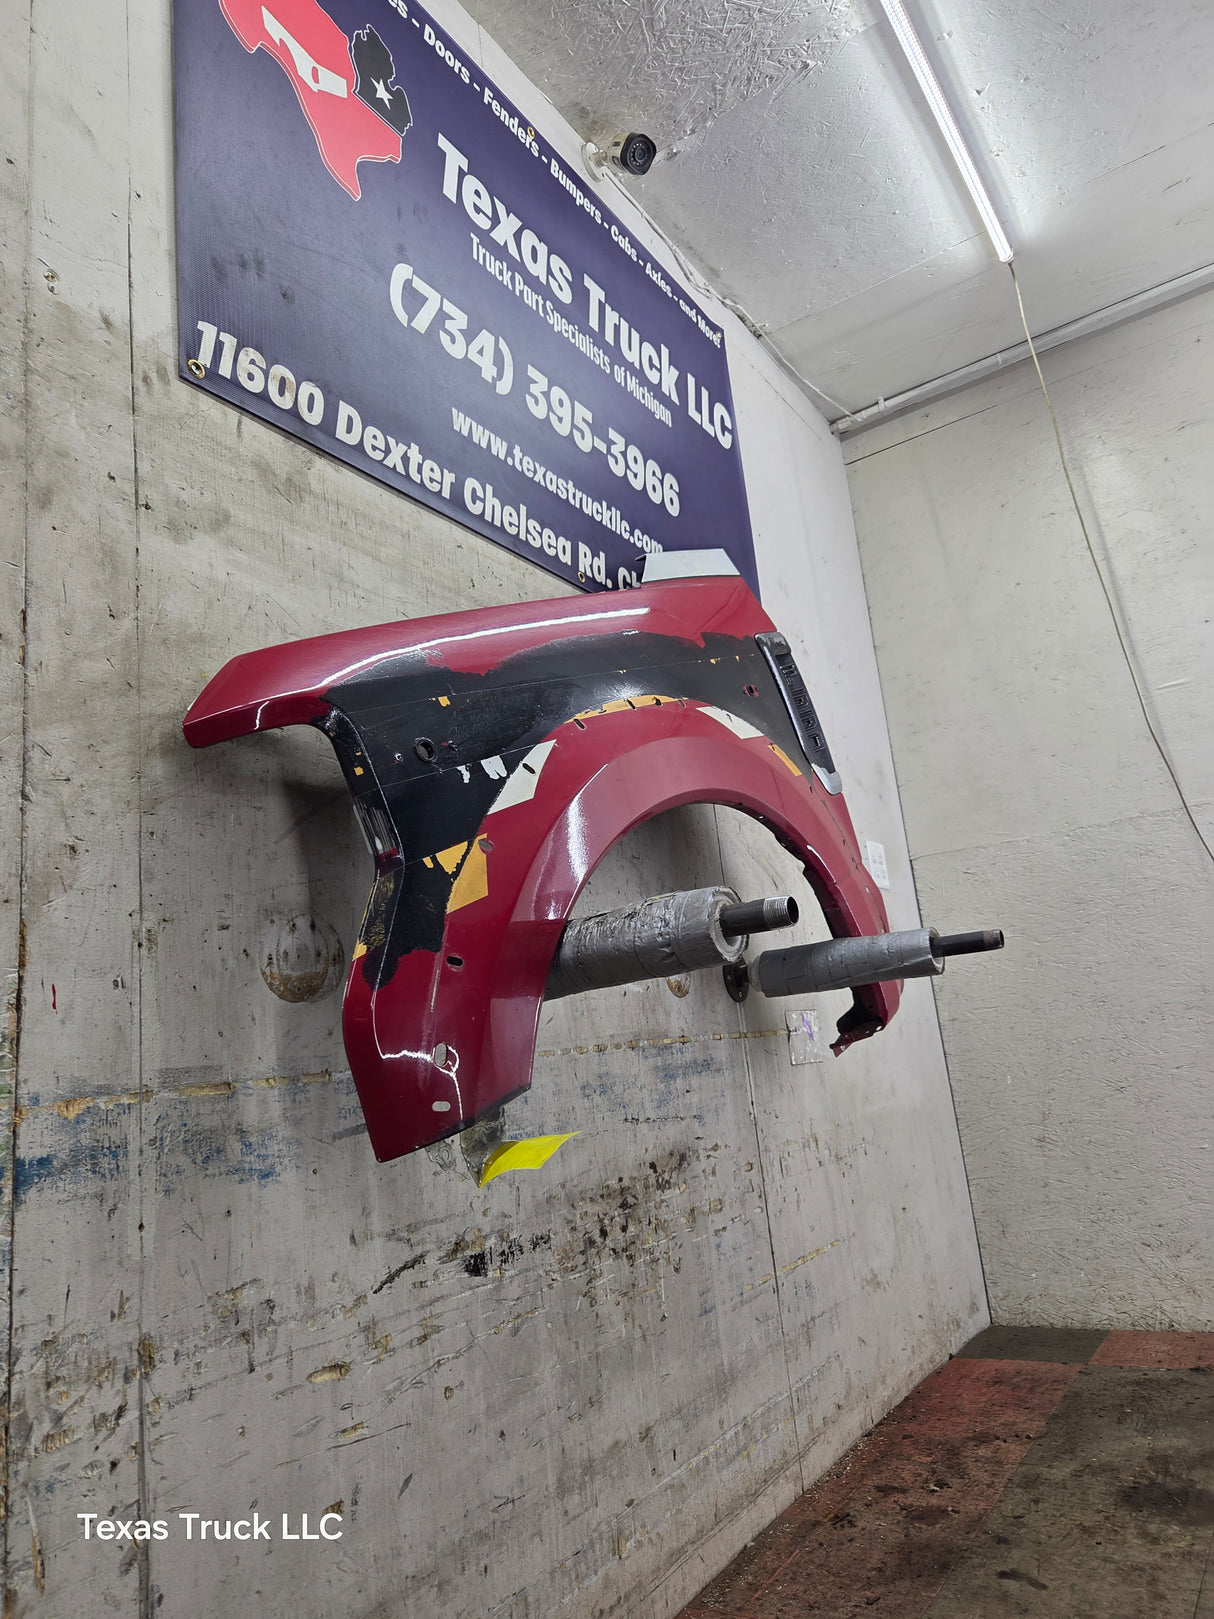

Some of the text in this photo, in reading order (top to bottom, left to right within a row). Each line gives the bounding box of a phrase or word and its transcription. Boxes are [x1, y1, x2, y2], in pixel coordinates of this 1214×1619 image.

[424, 24, 471, 84] Doors
[484, 87, 539, 158] Fenders
[550, 158, 602, 224] Bumpers
[611, 225, 638, 262] Cabs
[645, 262, 673, 298] Axles
[680, 299, 697, 323] and
[437, 132, 733, 450] Texas Truck LLC
[197, 320, 325, 426] 11600
[335, 400, 456, 500] Dexter
[463, 477, 572, 566] Chelsea
[578, 541, 613, 589] Rd.
[389, 263, 680, 517] (734) 395-3966
[471, 232, 673, 428] Truck Part Specialists of Michigan
[452, 407, 664, 553] www.texastruckllc.com
